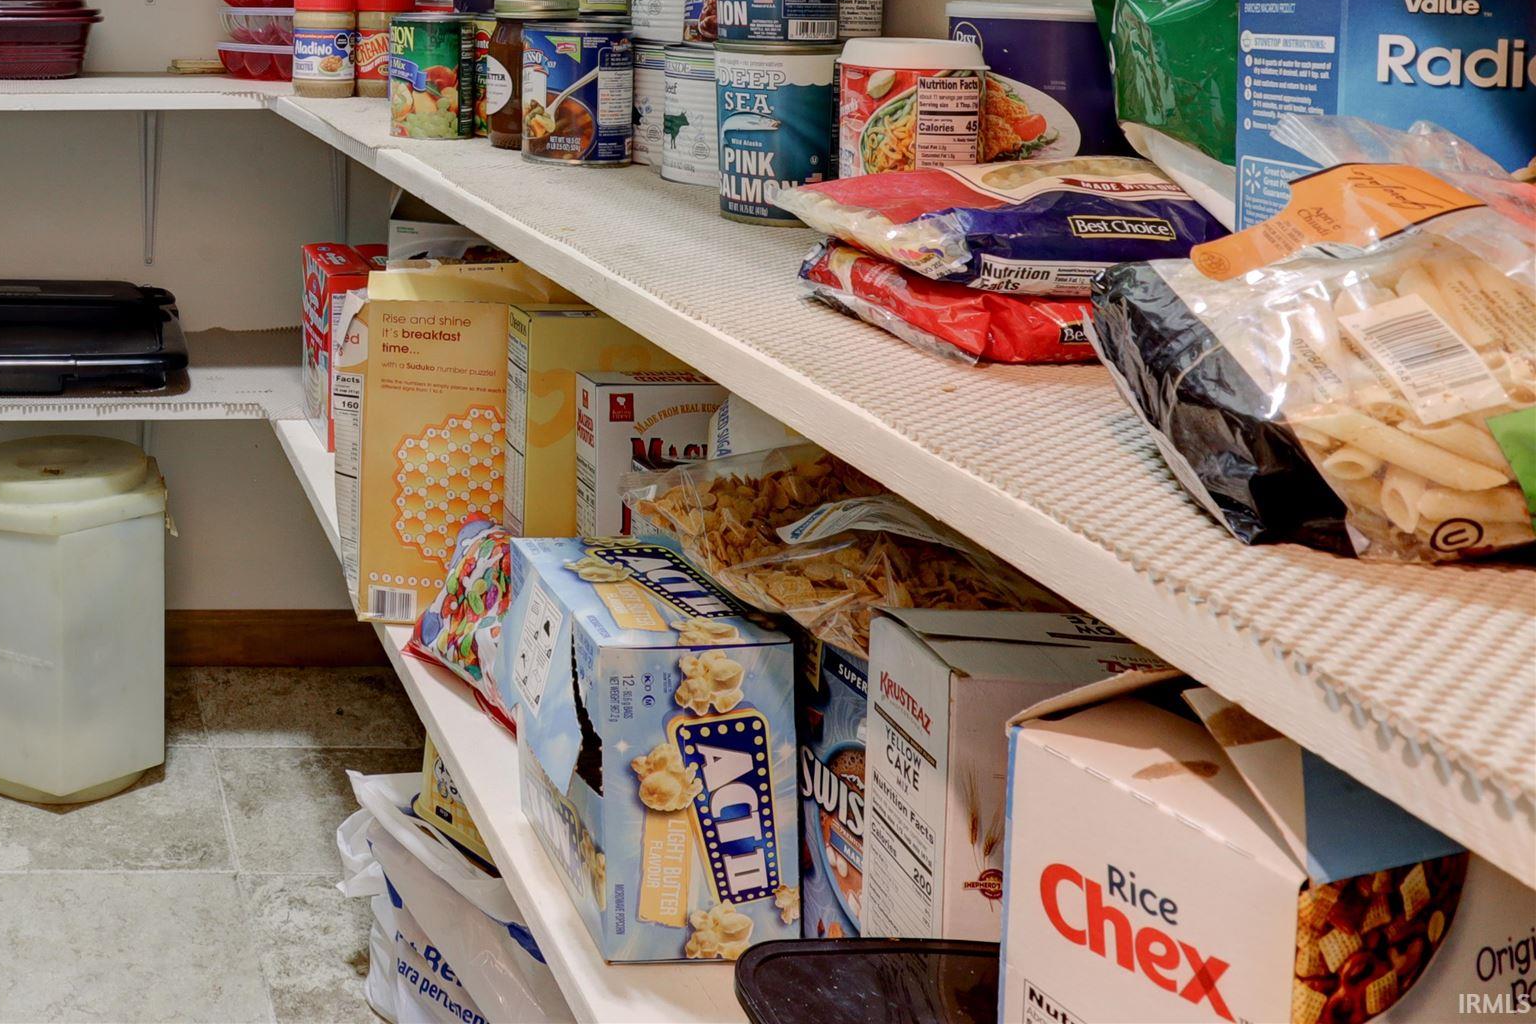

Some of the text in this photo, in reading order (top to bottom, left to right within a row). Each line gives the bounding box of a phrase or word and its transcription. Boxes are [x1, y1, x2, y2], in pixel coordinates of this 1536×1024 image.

[1254, 37, 1327, 50] STOVETOP INSTRUCTIONS:
[393, 59, 406, 71] Mix
[717, 66, 787, 91] DEEP
[919, 79, 978, 90] Nutrition Facts
[919, 120, 978, 132] Calories 45
[742, 139, 763, 148] Alaska
[724, 147, 775, 177] PINK
[1264, 166, 1280, 176] Great
[1080, 180, 1122, 192] MADE
[1310, 206, 1335, 225] Apri
[1075, 218, 1170, 236] Best Choice
[981, 261, 1051, 281] Nutrition
[382, 313, 472, 328] Rise and shine
[381, 328, 462, 343] It's breakfast
[381, 342, 420, 356] time...
[381, 361, 398, 369] with
[405, 362, 436, 372] Suduko
[436, 365, 468, 374] number
[335, 375, 361, 384] Facts
[432, 381, 450, 390] empty
[450, 383, 468, 391] places
[341, 400, 360, 410] 160
[633, 413, 659, 436] MADE
[657, 406, 680, 421] FROM
[680, 403, 701, 414] REAL
[609, 676, 621, 704] NET WEIGHT
[622, 674, 636, 720] 12 BAGS
[879, 670, 933, 736] KRUSTEAZ
[885, 724, 922, 771] YELLOW
[886, 743, 920, 792] CAKE
[695, 742, 764, 844] ACT
[895, 776, 909, 795] MIX
[873, 770, 908, 818] Nutrition
[910, 811, 934, 845] Facts
[645, 839, 664, 890] FLAVOUR
[660, 818, 689, 917] LIGHT BUTTER
[871, 821, 933, 897] Calories 200
[1106, 863, 1179, 926] Rice
[615, 883, 626, 936] MICROWAVE POPCORN
[1038, 862, 1237, 1024] Chex
